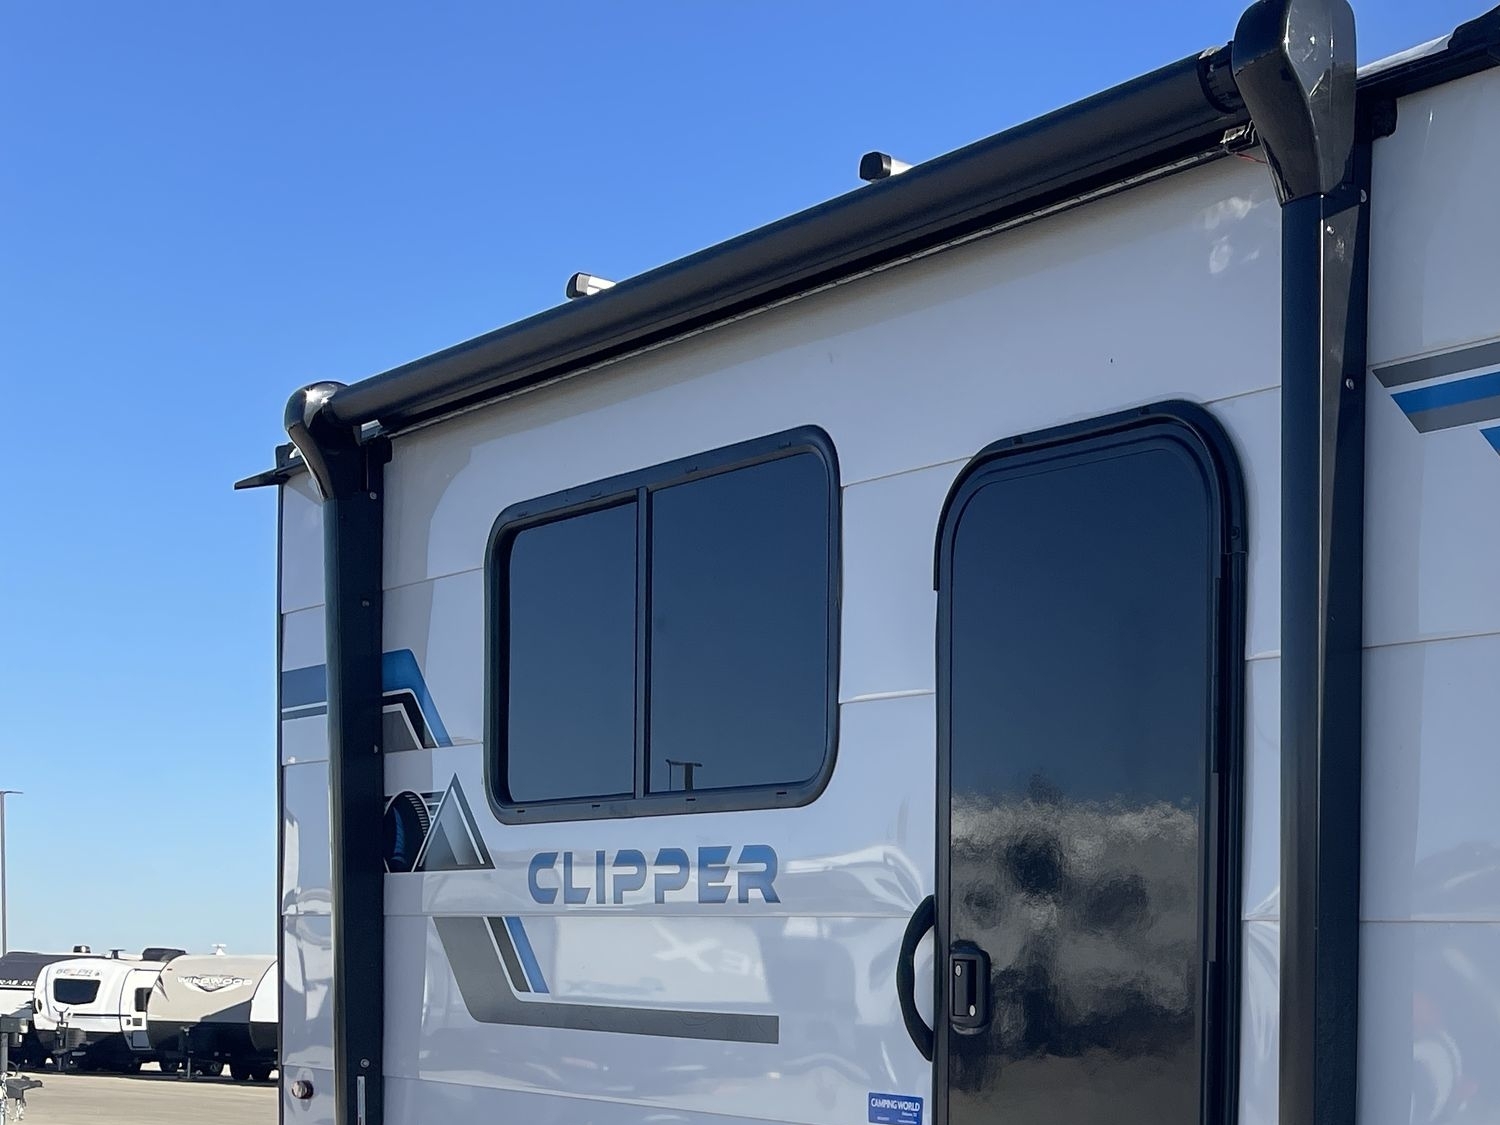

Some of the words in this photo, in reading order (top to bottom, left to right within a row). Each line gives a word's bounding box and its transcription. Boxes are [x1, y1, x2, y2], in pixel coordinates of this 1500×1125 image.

[527, 844, 781, 905] CLIPPER
[871, 1098, 897, 1109] CAMPING
[897, 1101, 920, 1111] WORLD
